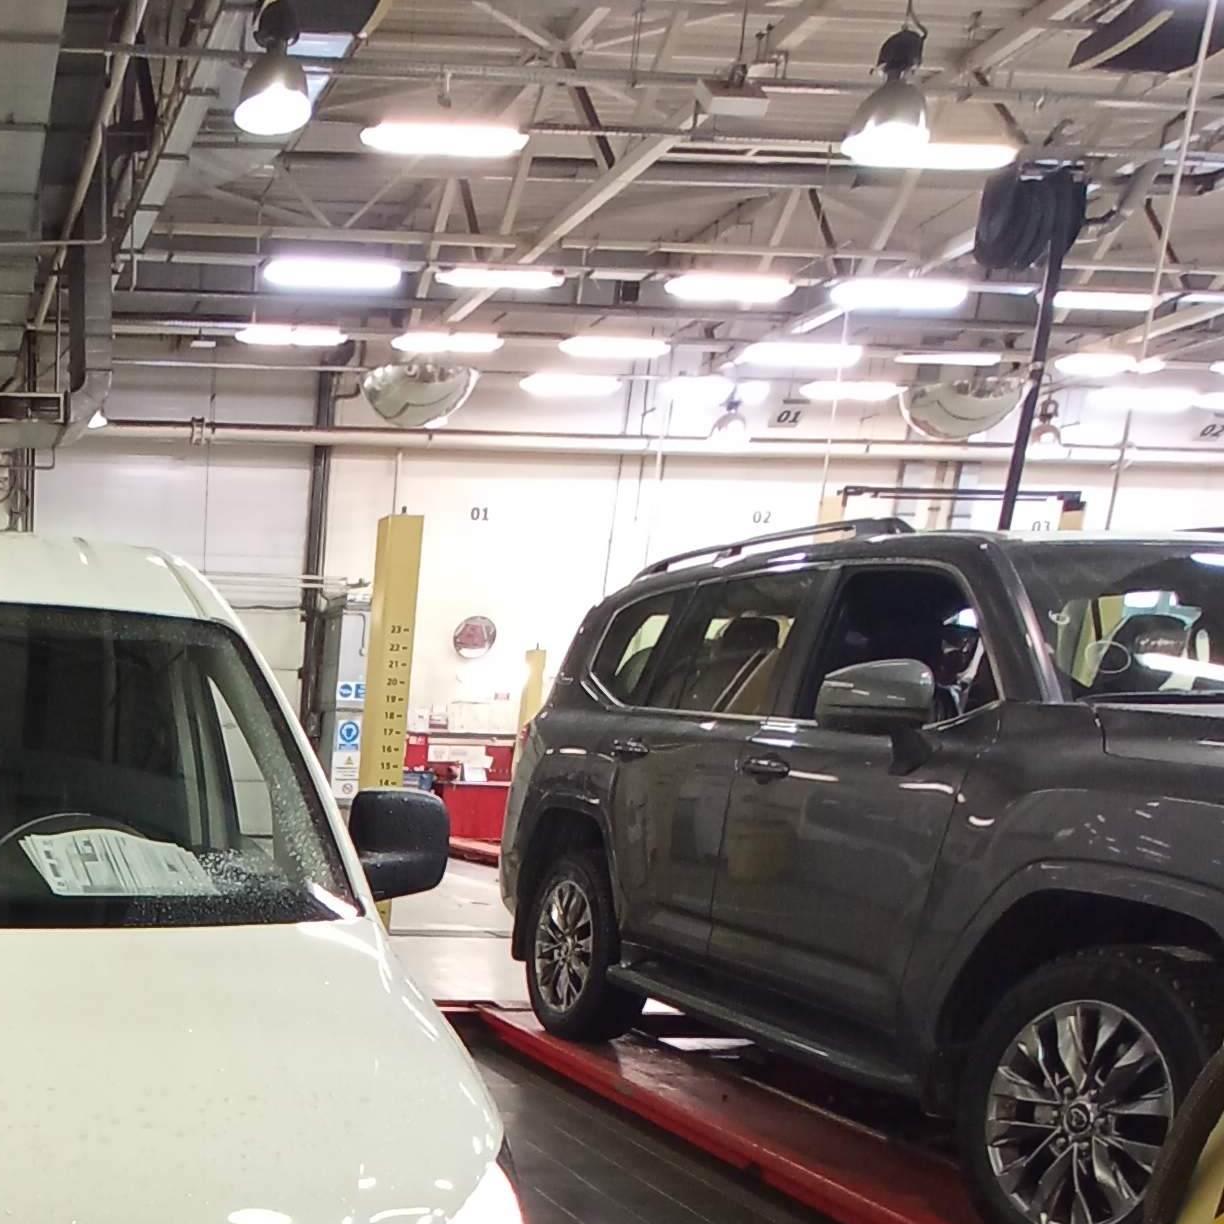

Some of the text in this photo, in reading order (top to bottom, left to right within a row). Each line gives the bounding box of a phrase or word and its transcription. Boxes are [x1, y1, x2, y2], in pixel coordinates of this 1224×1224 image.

[776, 410, 801, 424] 01
[470, 506, 489, 521] 01
[752, 511, 772, 524] 02
